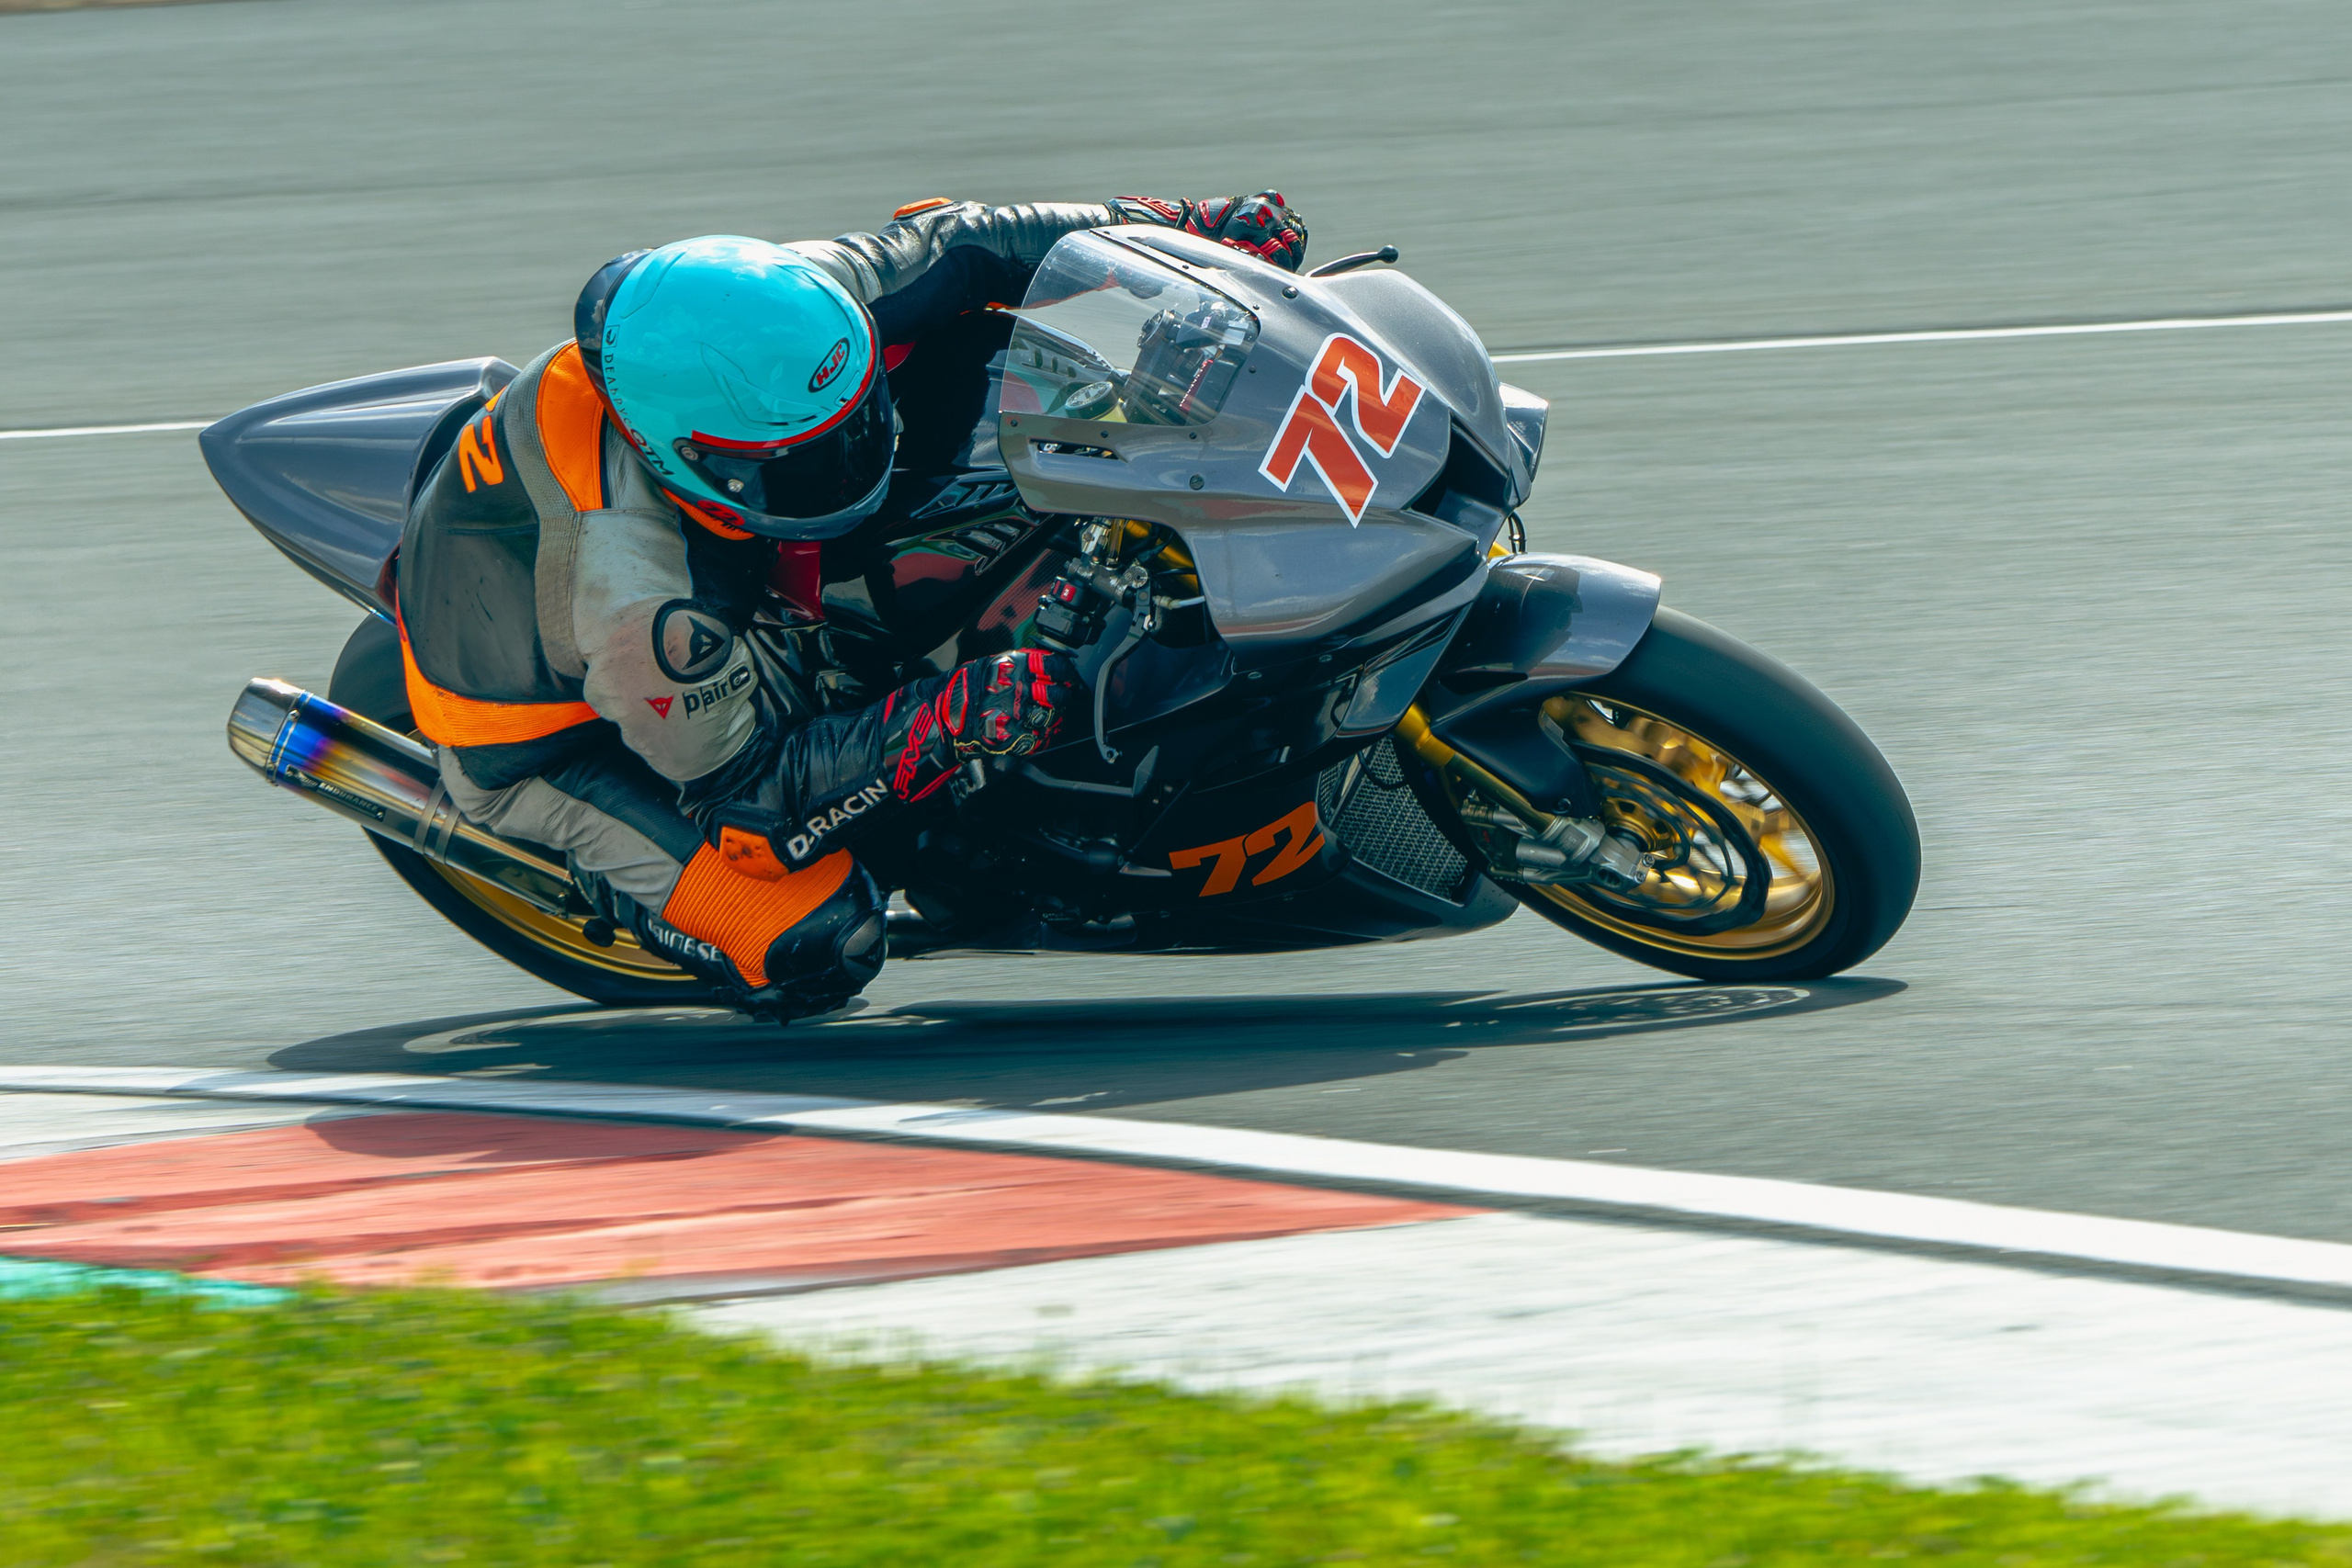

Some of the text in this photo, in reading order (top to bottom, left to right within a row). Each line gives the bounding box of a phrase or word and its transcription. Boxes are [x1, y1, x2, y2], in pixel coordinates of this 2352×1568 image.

[816, 343, 845, 387] HJC
[1259, 333, 1426, 528] 72
[1169, 801, 1326, 897] 72
